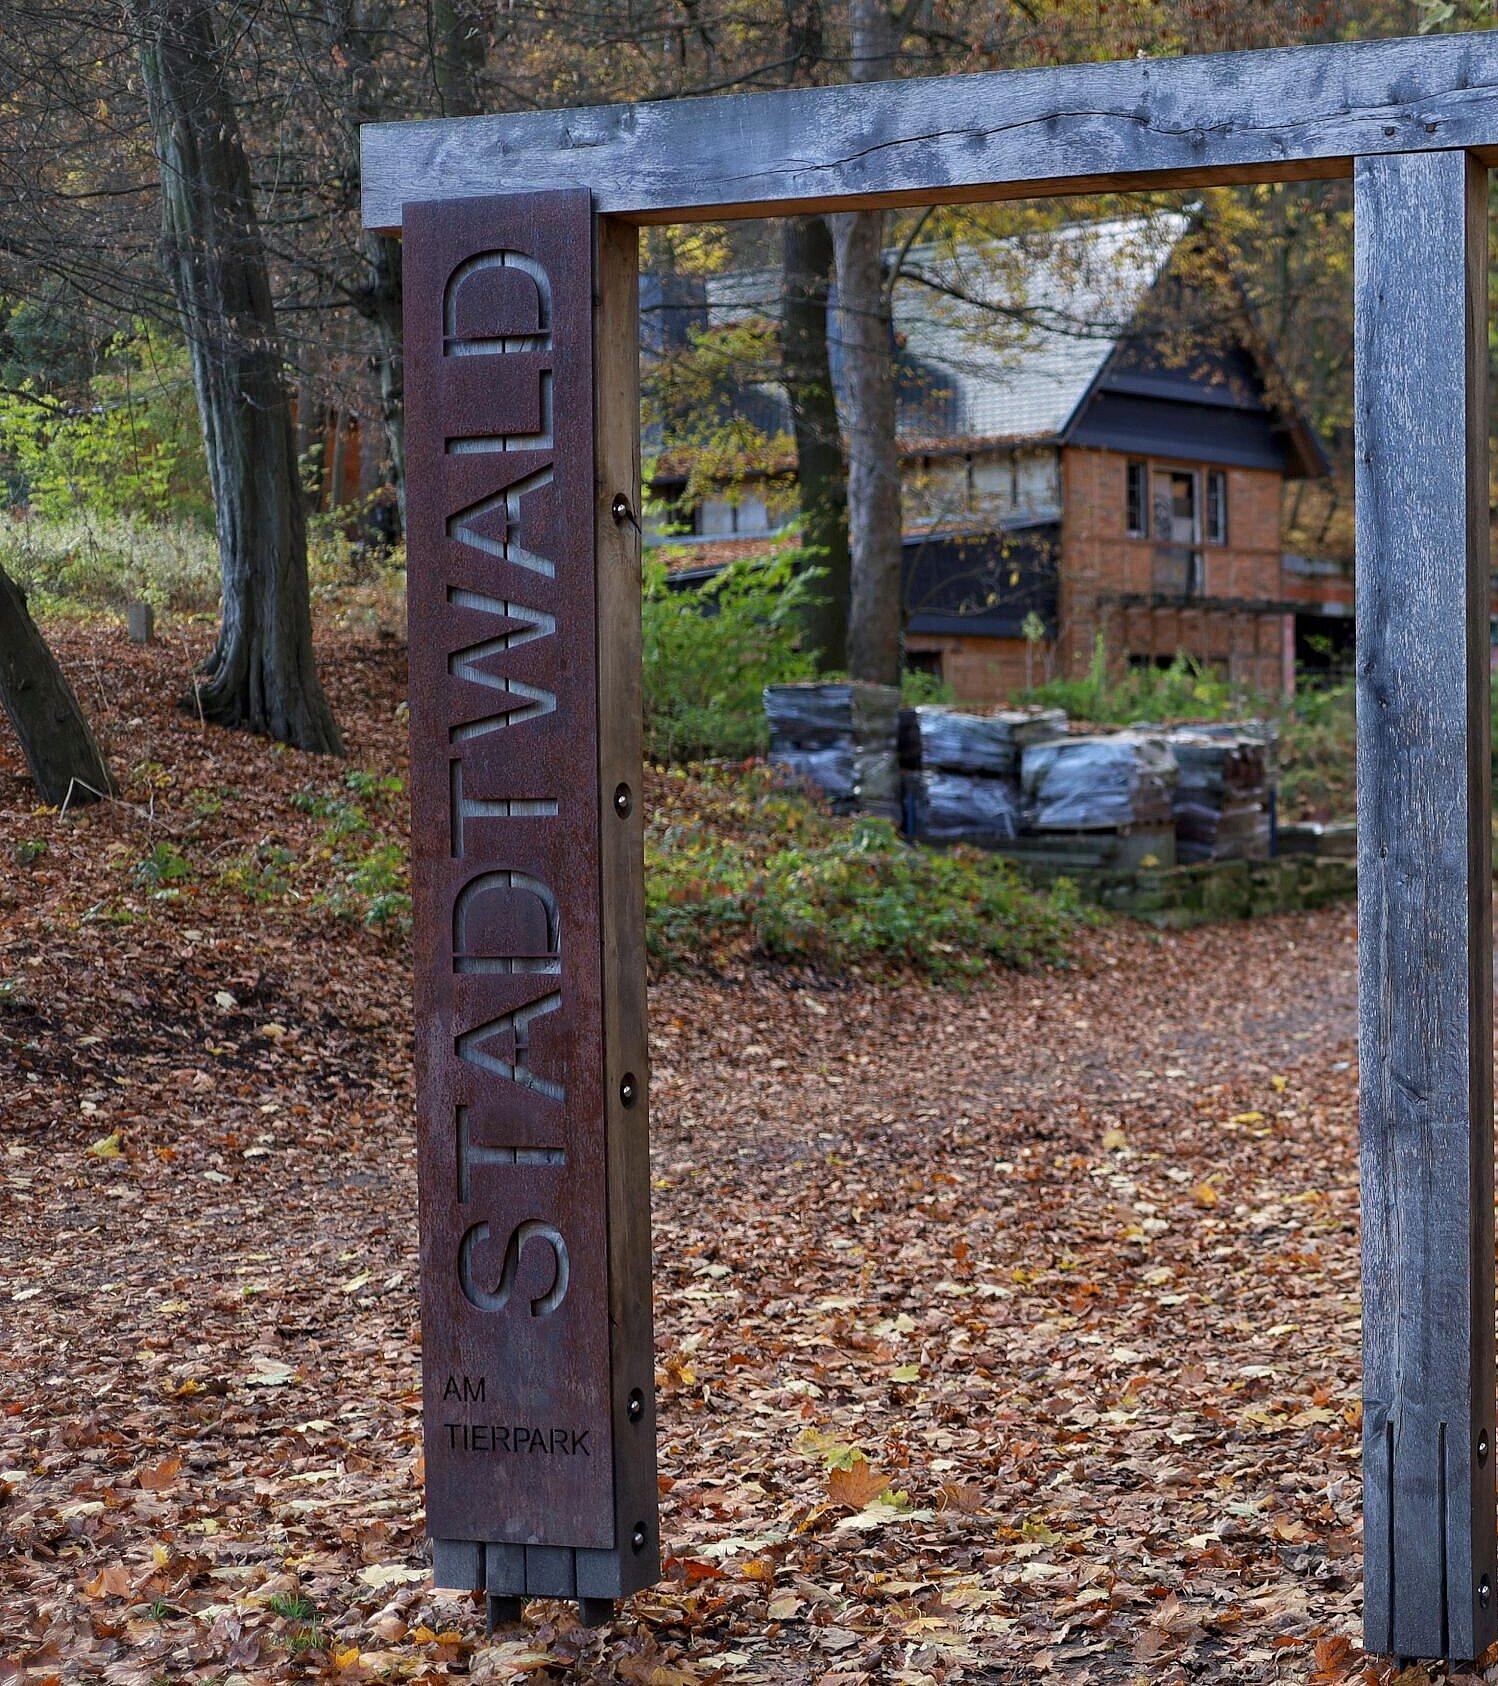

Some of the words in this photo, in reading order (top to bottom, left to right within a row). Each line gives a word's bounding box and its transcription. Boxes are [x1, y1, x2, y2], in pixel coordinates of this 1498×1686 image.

[443, 249, 570, 1316] STADTWALD
[443, 1376, 486, 1402] AM
[444, 1424, 590, 1456] TIERPARK
